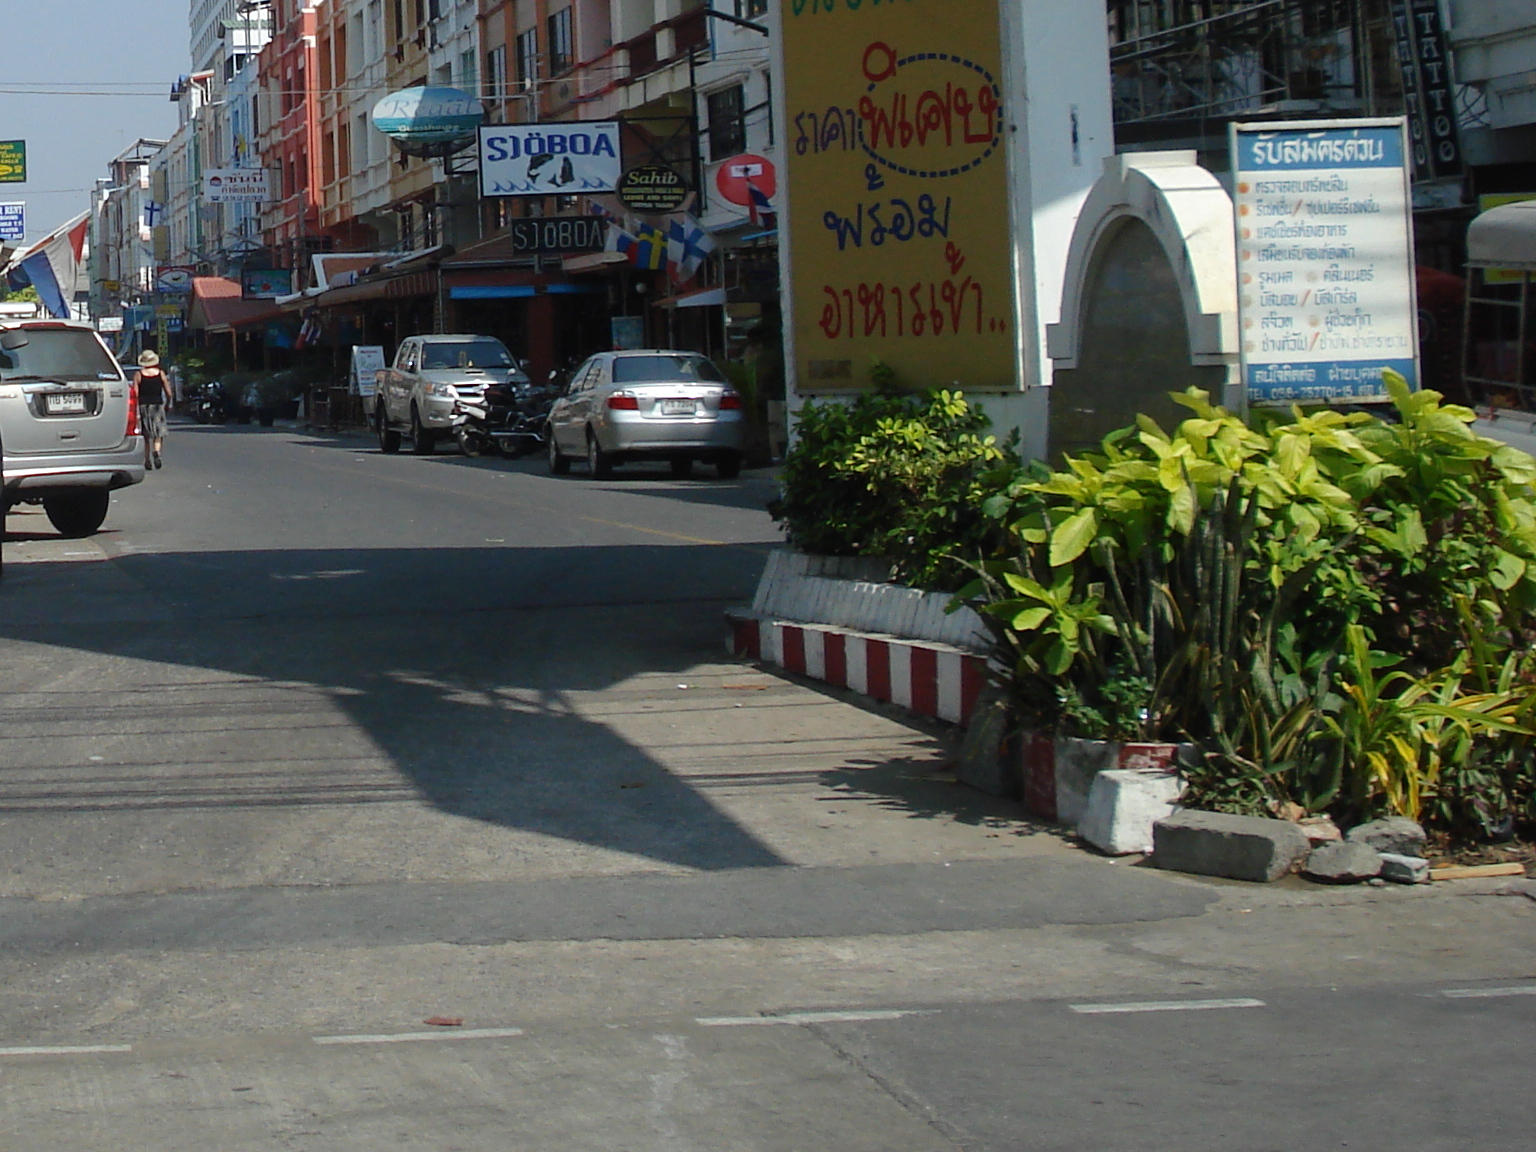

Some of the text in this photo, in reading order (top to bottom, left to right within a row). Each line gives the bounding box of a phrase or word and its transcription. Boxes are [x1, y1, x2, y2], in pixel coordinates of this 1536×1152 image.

[1415, 11, 1455, 162] TATTOO
[1253, 129, 1384, 165] รับสมัครด่วน
[627, 171, 678, 185] Sahib
[4, 205, 23, 214] RENT
[823, 163, 951, 251] พร้อม
